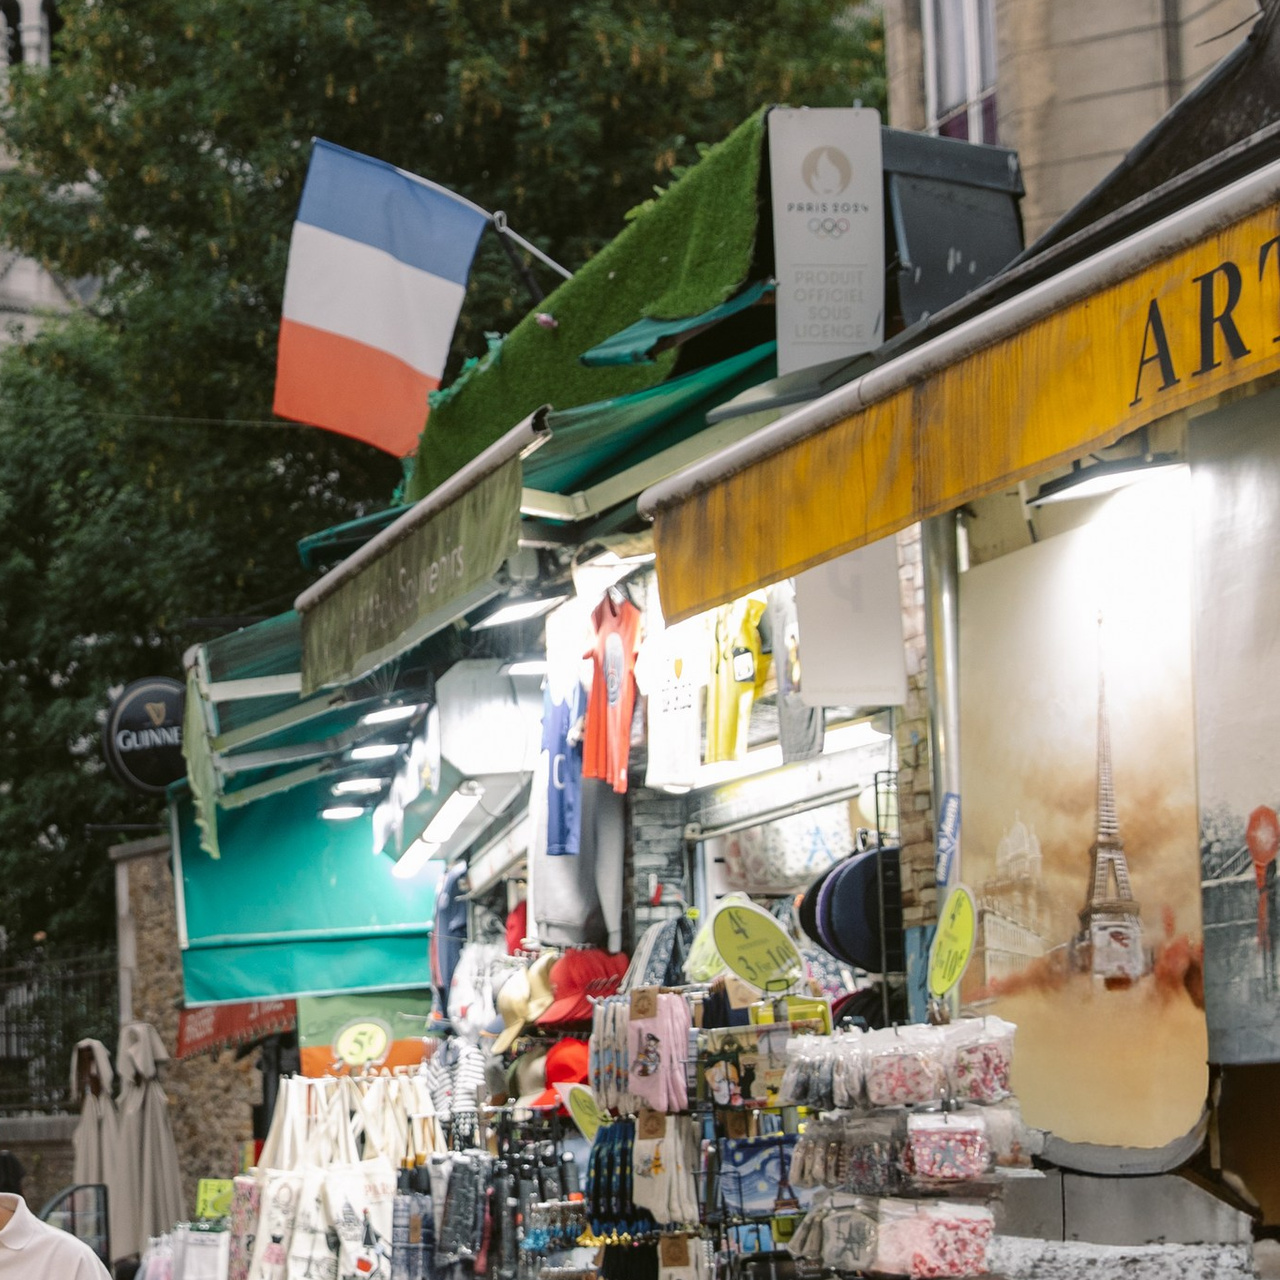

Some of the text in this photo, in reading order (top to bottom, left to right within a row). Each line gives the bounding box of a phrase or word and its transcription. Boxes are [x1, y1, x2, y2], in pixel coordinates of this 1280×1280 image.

[787, 202, 869, 213] PARIS 2024
[794, 270, 864, 285] PRODUIT
[793, 288, 864, 303] OFFICIEL
[808, 306, 851, 320] SOUS
[794, 324, 864, 338] LICENCE
